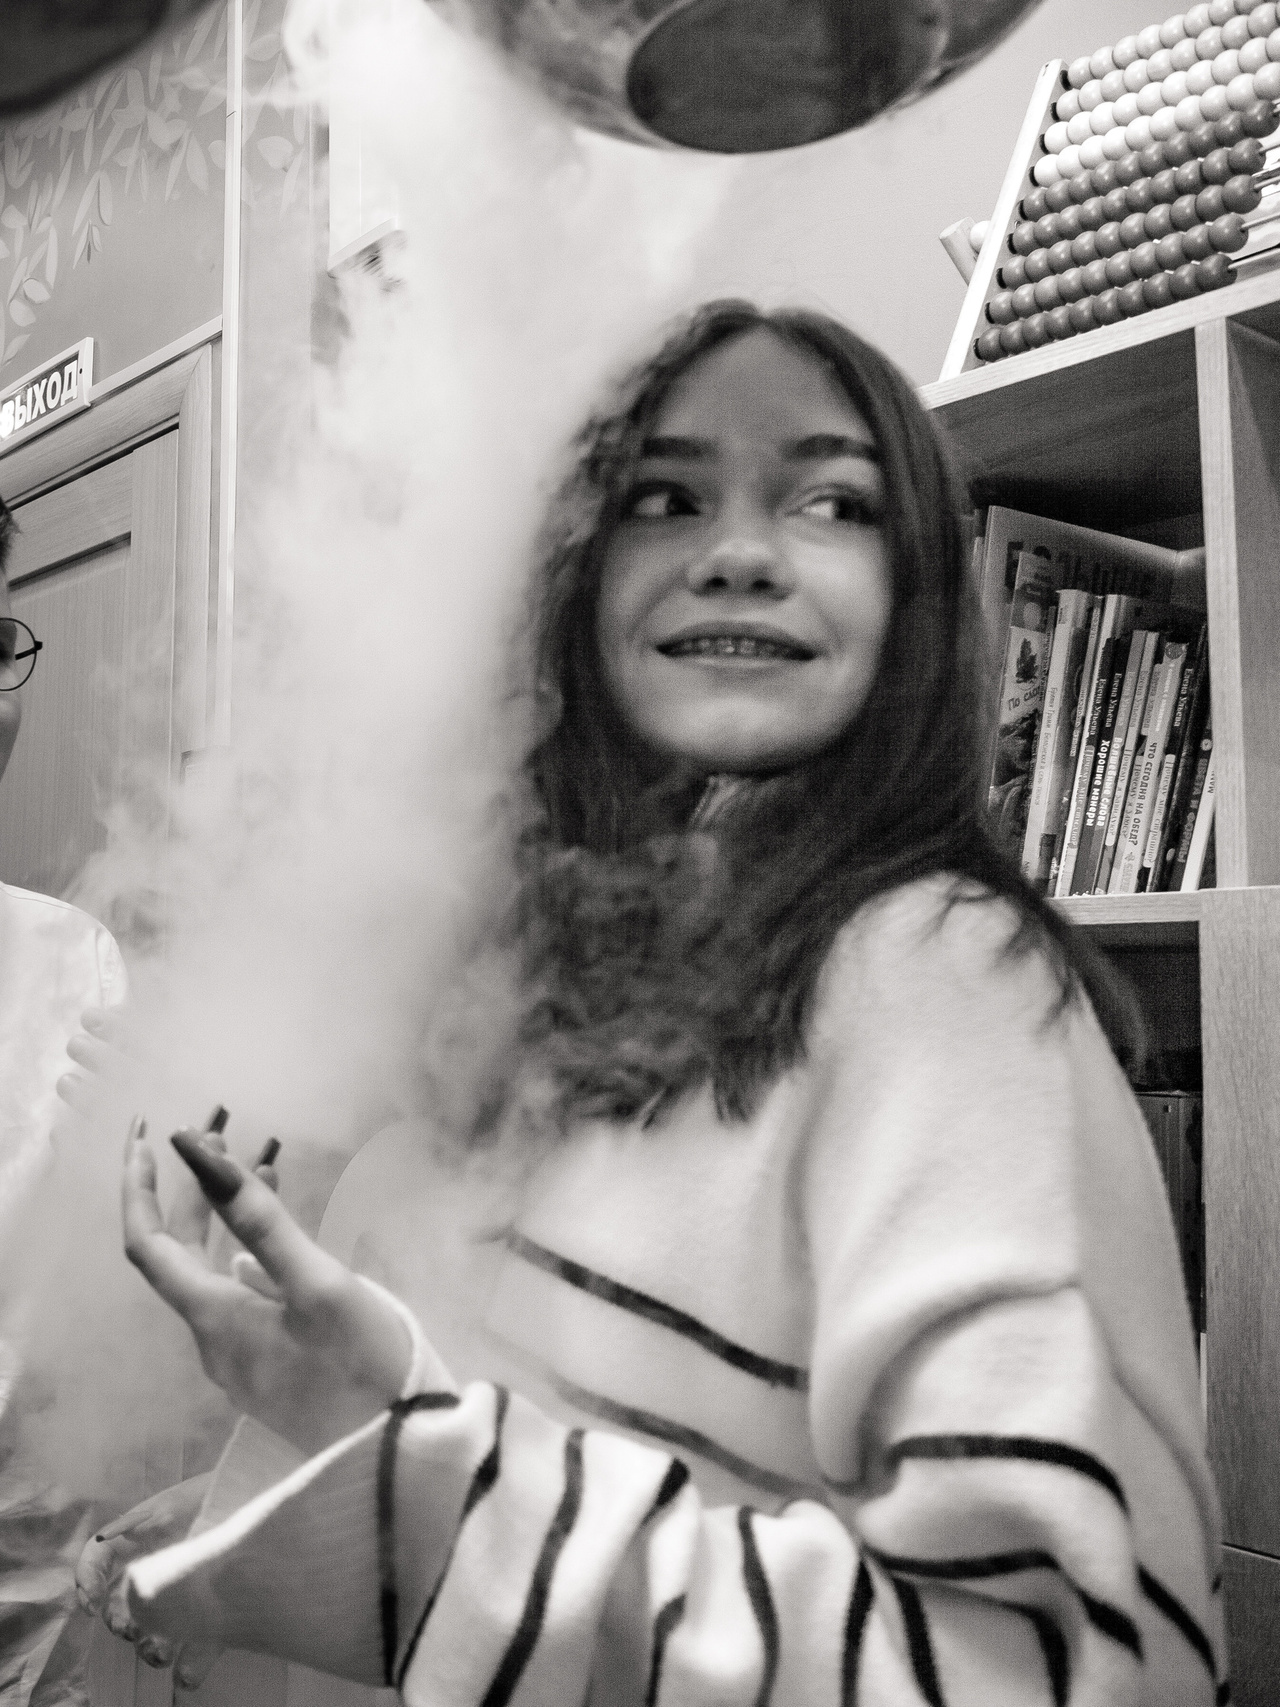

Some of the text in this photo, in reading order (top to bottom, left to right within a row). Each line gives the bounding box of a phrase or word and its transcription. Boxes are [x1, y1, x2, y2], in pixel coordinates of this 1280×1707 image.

[1089, 677, 1106, 736] Елена Ульева
[1104, 671, 1122, 728] Елена Ульева
[1116, 670, 1135, 726] Елена Ульева
[1129, 669, 1147, 728] Елена Ульева
[1172, 667, 1193, 728] Елена Ульева
[1079, 748, 1093, 783] Почему
[1083, 739, 1109, 826] Хорошие манеры
[1095, 735, 1122, 827] Волшебные слова
[1118, 748, 1132, 783] Почему
[1127, 763, 1141, 799] Почему
[1127, 741, 1157, 846] ЧТО СЕГОДНЯ НА ОБЕД?
[1076, 786, 1086, 804] мне
[1107, 794, 1122, 836] завидую?
[1143, 761, 1173, 864] Почему мне страшно?
[1175, 810, 1195, 864] ФОРМЫ
